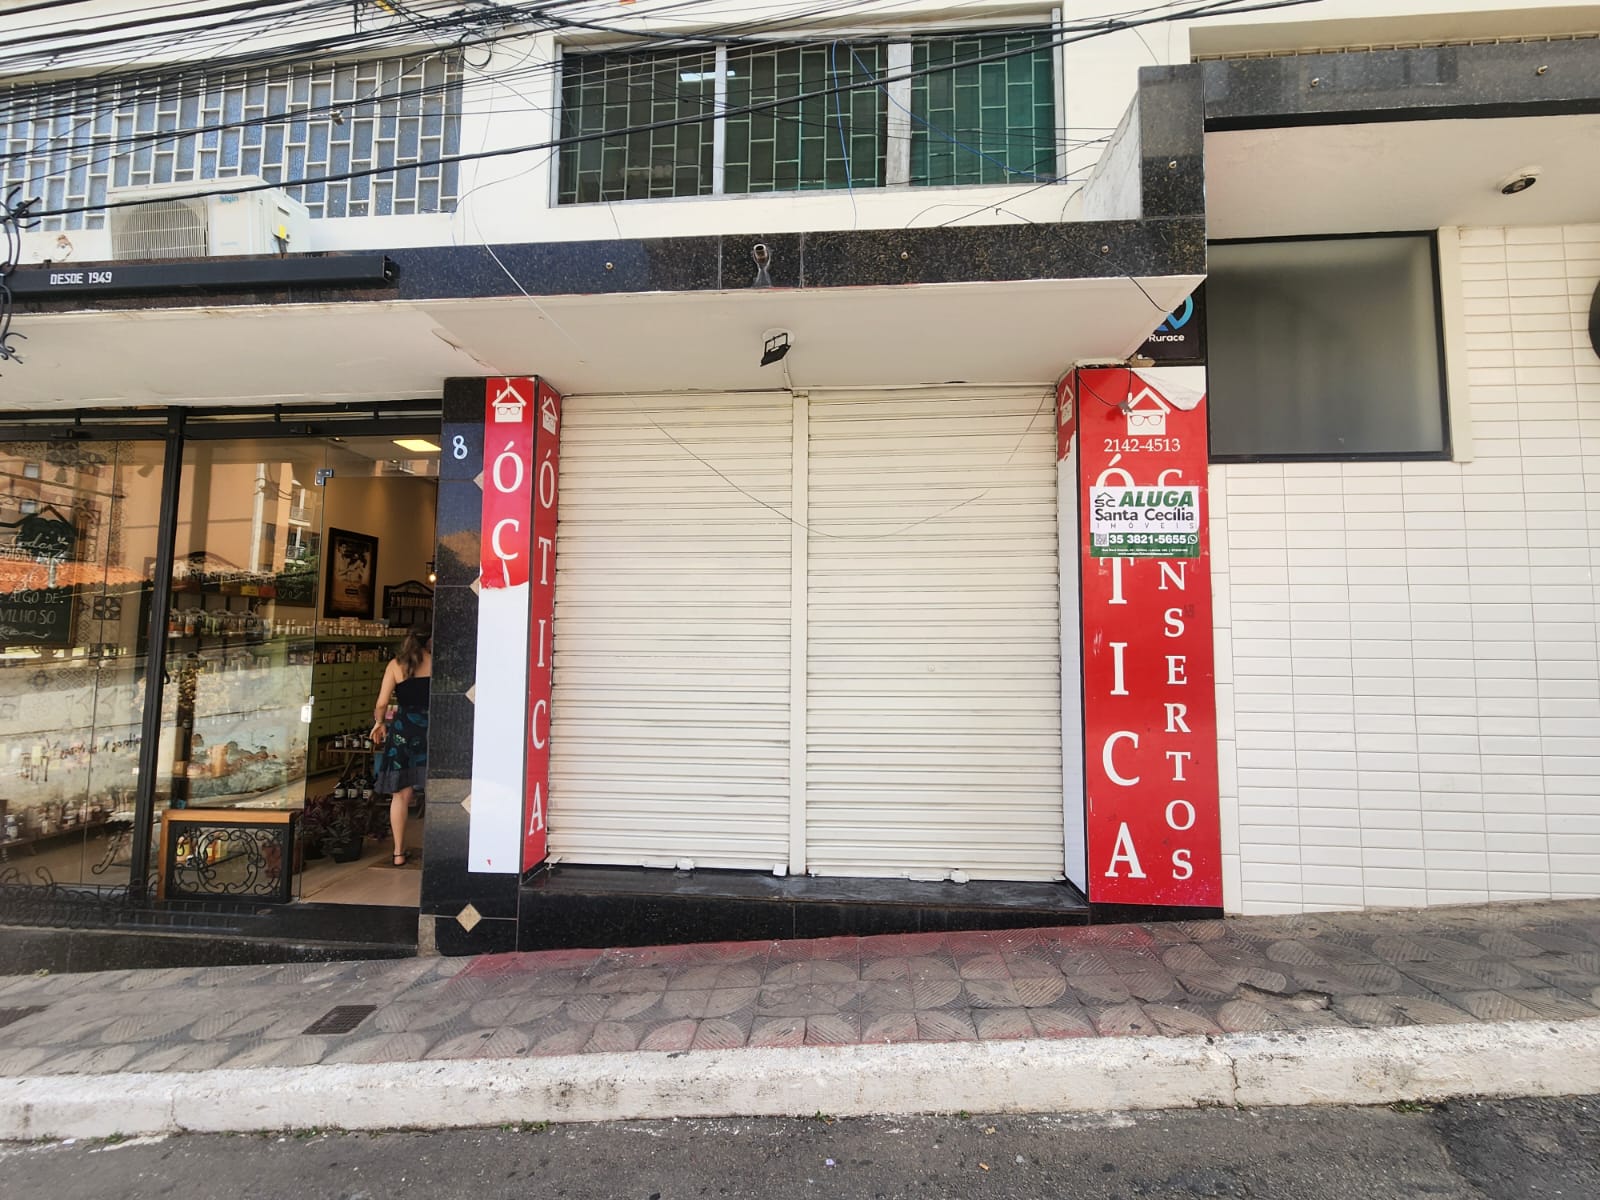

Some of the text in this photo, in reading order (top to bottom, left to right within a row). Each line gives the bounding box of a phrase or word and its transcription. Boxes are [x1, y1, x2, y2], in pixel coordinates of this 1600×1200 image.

[50, 271, 113, 285] DESDE 1949
[452, 434, 468, 460] 8
[1103, 438, 1181, 453] 2142-4513
[1118, 490, 1194, 508] ALUGA
[1095, 507, 1194, 521] Santa Cecília
[1109, 534, 1187, 544] 35 3821-5655
[528, 449, 555, 836] ÓTICA
[1156, 468, 1197, 880] CNSERTOS
